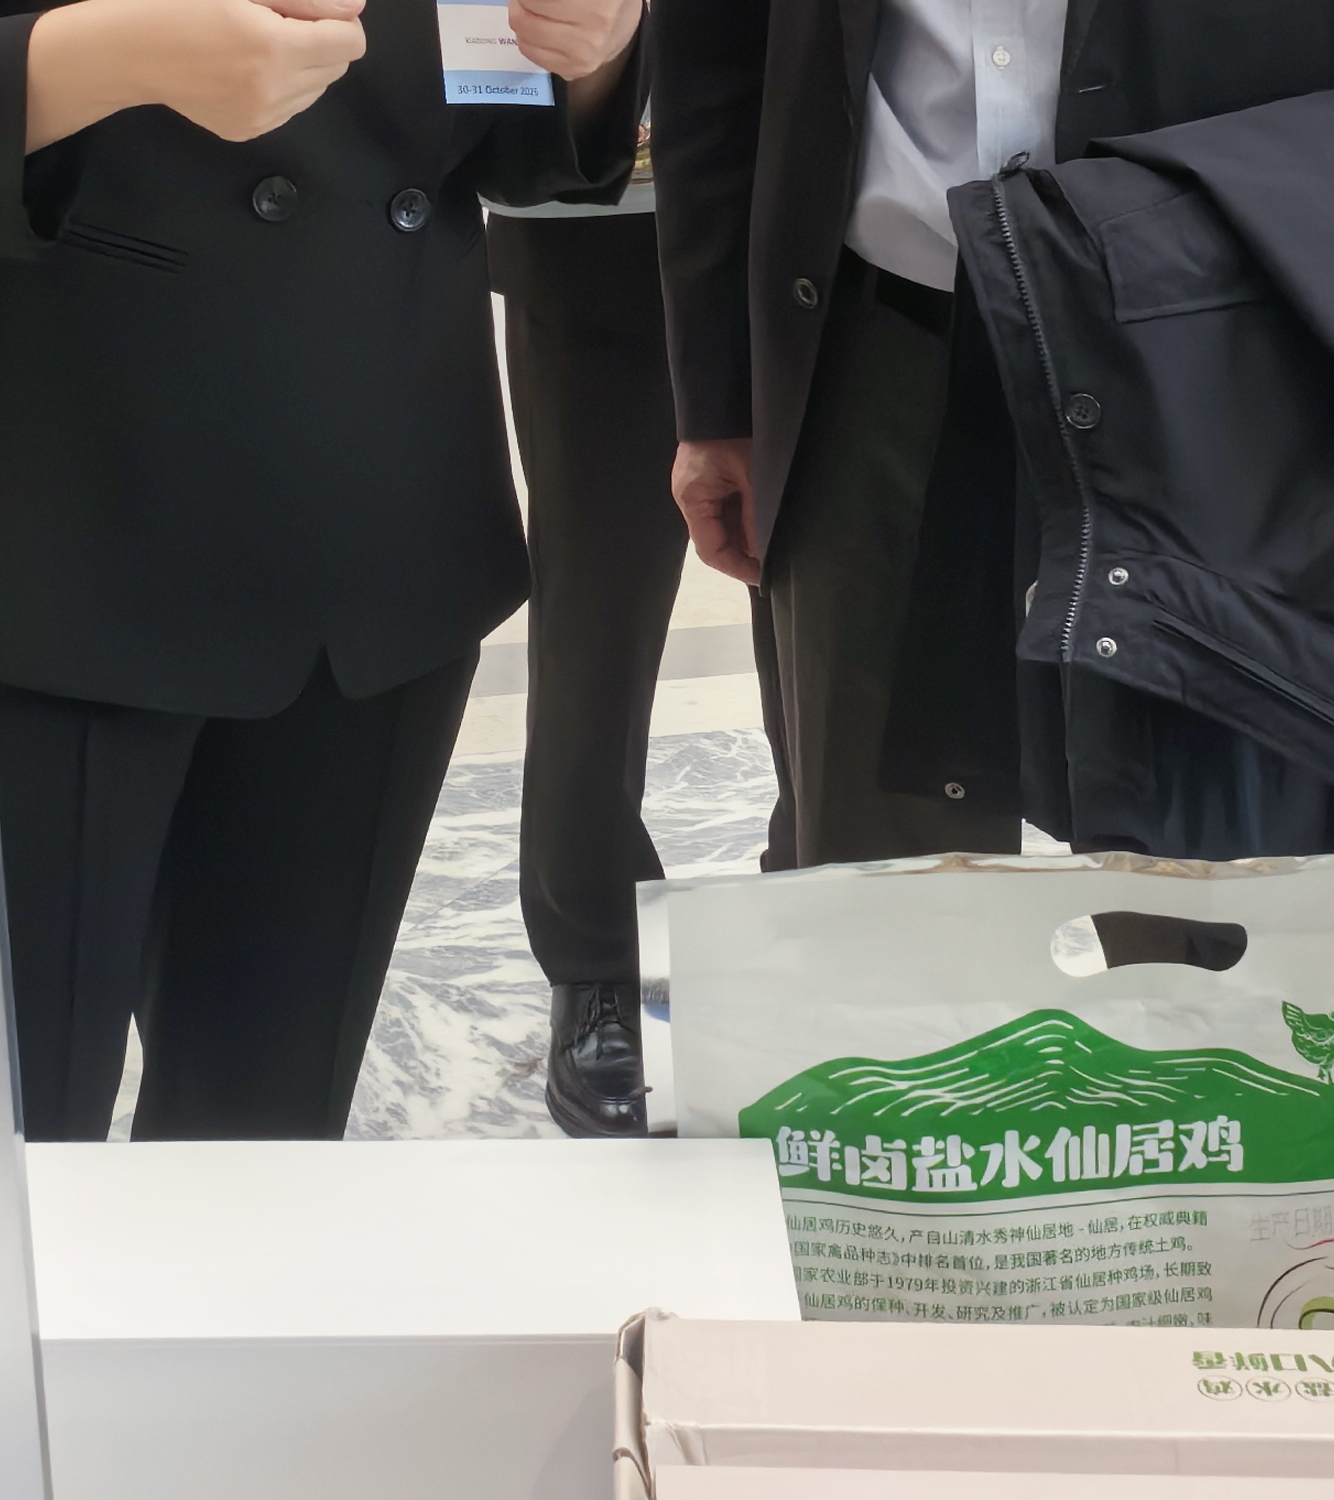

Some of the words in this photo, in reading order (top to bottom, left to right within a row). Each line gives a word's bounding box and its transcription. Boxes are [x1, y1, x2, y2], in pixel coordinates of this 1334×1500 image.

[485, 84, 518, 96] October
[774, 1114, 1245, 1192] 鲜卤盐水仙居鸡
